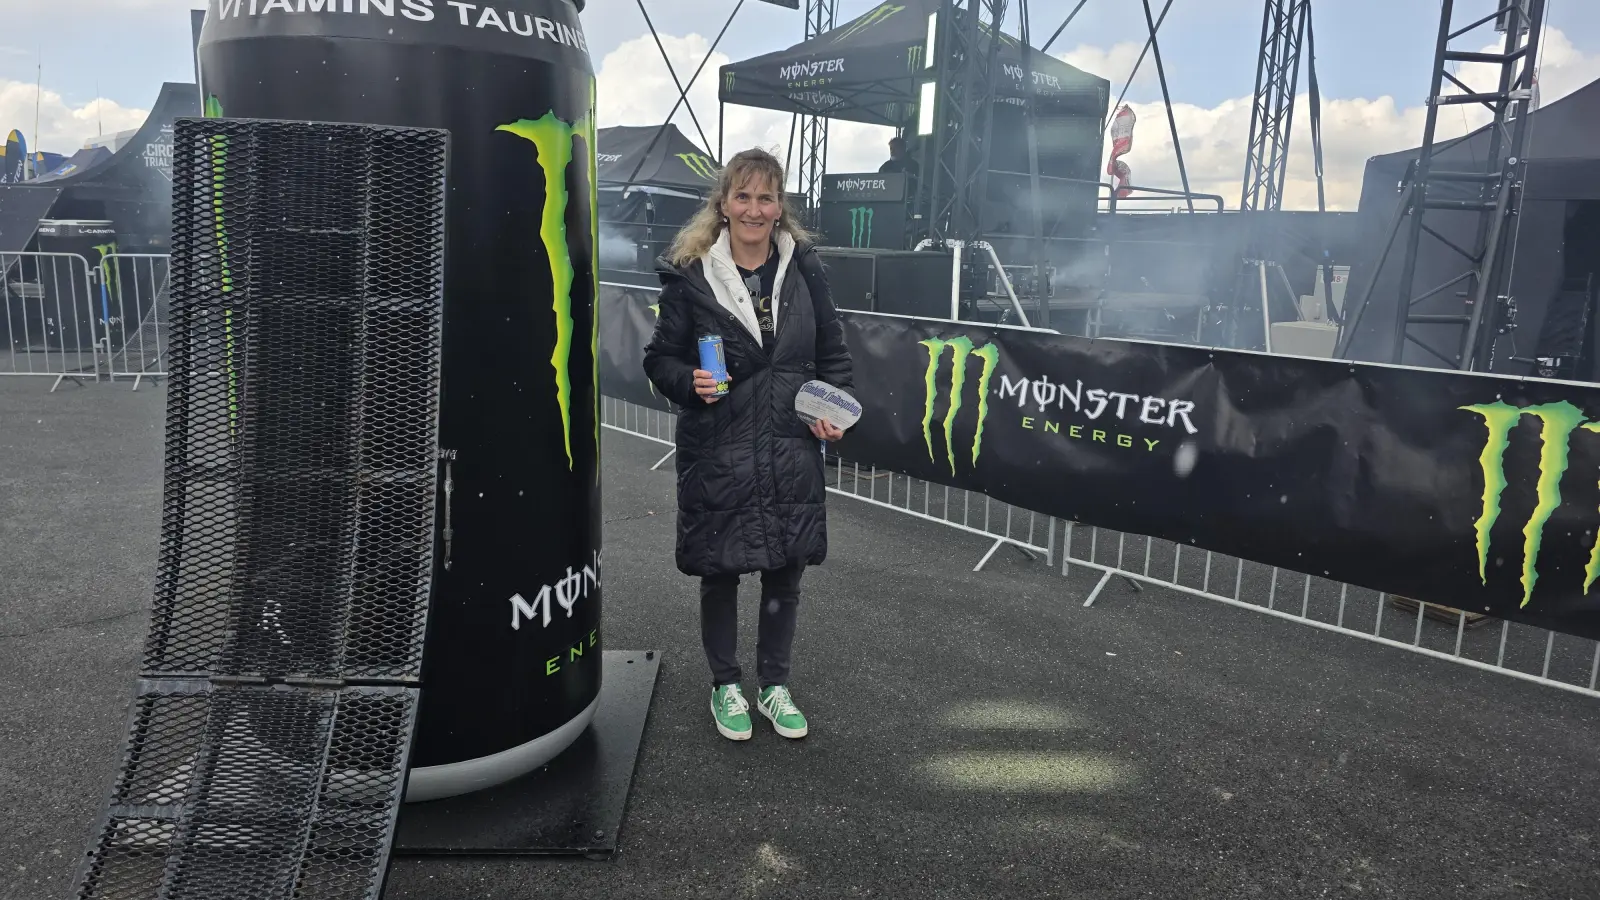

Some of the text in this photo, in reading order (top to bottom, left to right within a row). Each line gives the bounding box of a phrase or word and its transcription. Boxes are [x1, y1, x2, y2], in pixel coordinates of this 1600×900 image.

[218, 0, 588, 53] VITAMINS TAURINE
[780, 58, 845, 80] MONSTER
[788, 78, 833, 88] ENERGY
[1003, 63, 1061, 90] MOSTER
[836, 177, 886, 192] MONSTER
[1000, 375, 1198, 434] MONSTER
[1022, 416, 1160, 451] ENERGY
[546, 629, 597, 675] ENE
